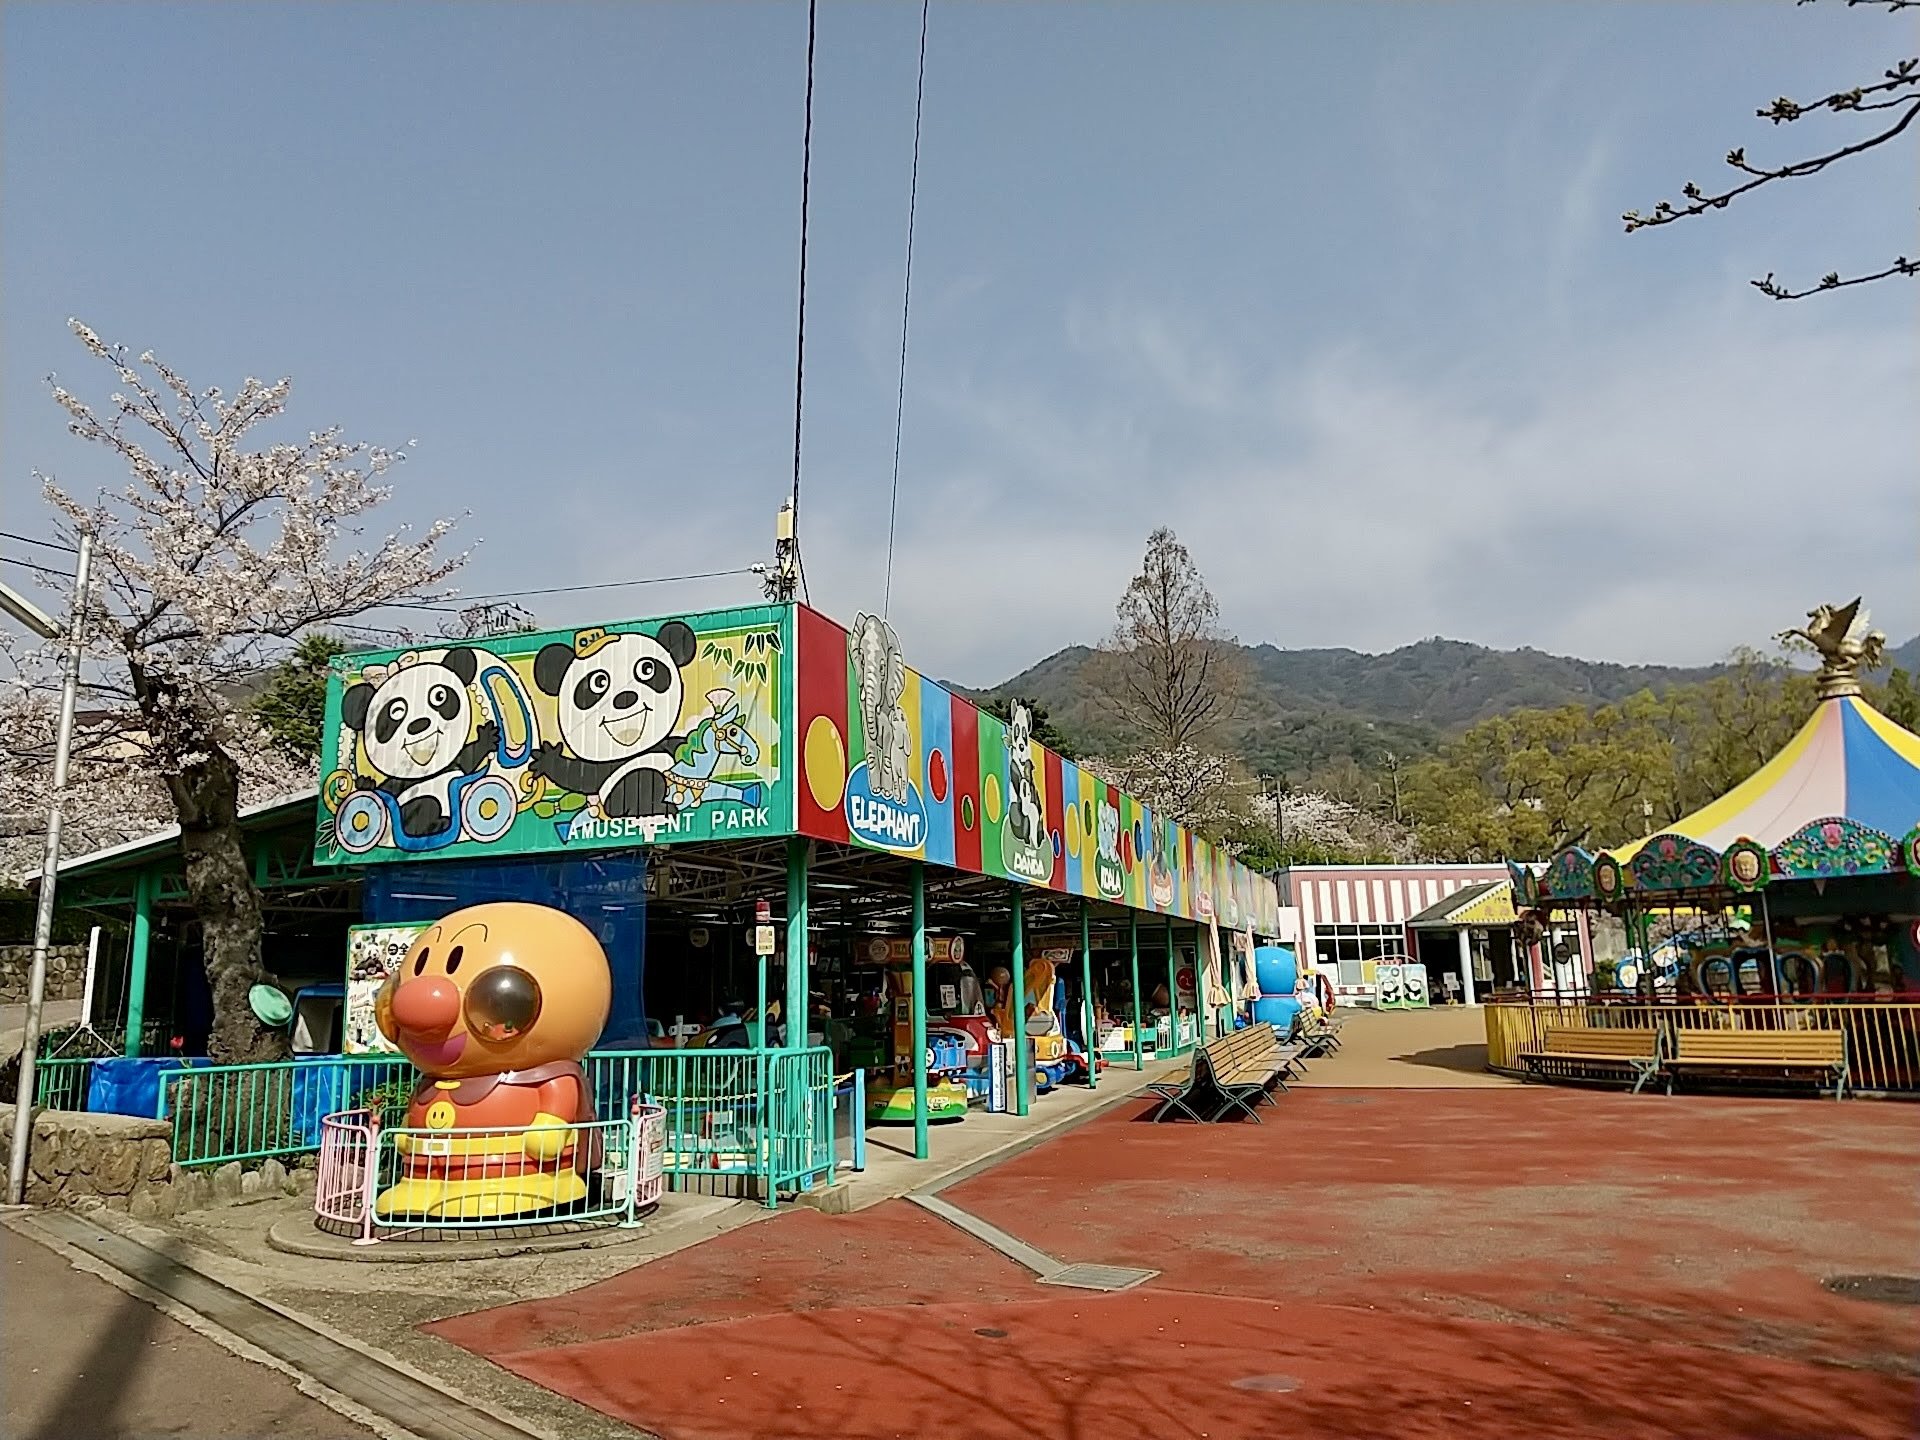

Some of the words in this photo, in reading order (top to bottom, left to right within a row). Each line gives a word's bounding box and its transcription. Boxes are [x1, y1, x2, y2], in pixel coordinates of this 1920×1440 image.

[711, 806, 770, 830] PARK
[851, 795, 921, 845] ELEPHANT
[1013, 851, 1045, 877] PANDA
[1100, 864, 1122, 895] KOALA
